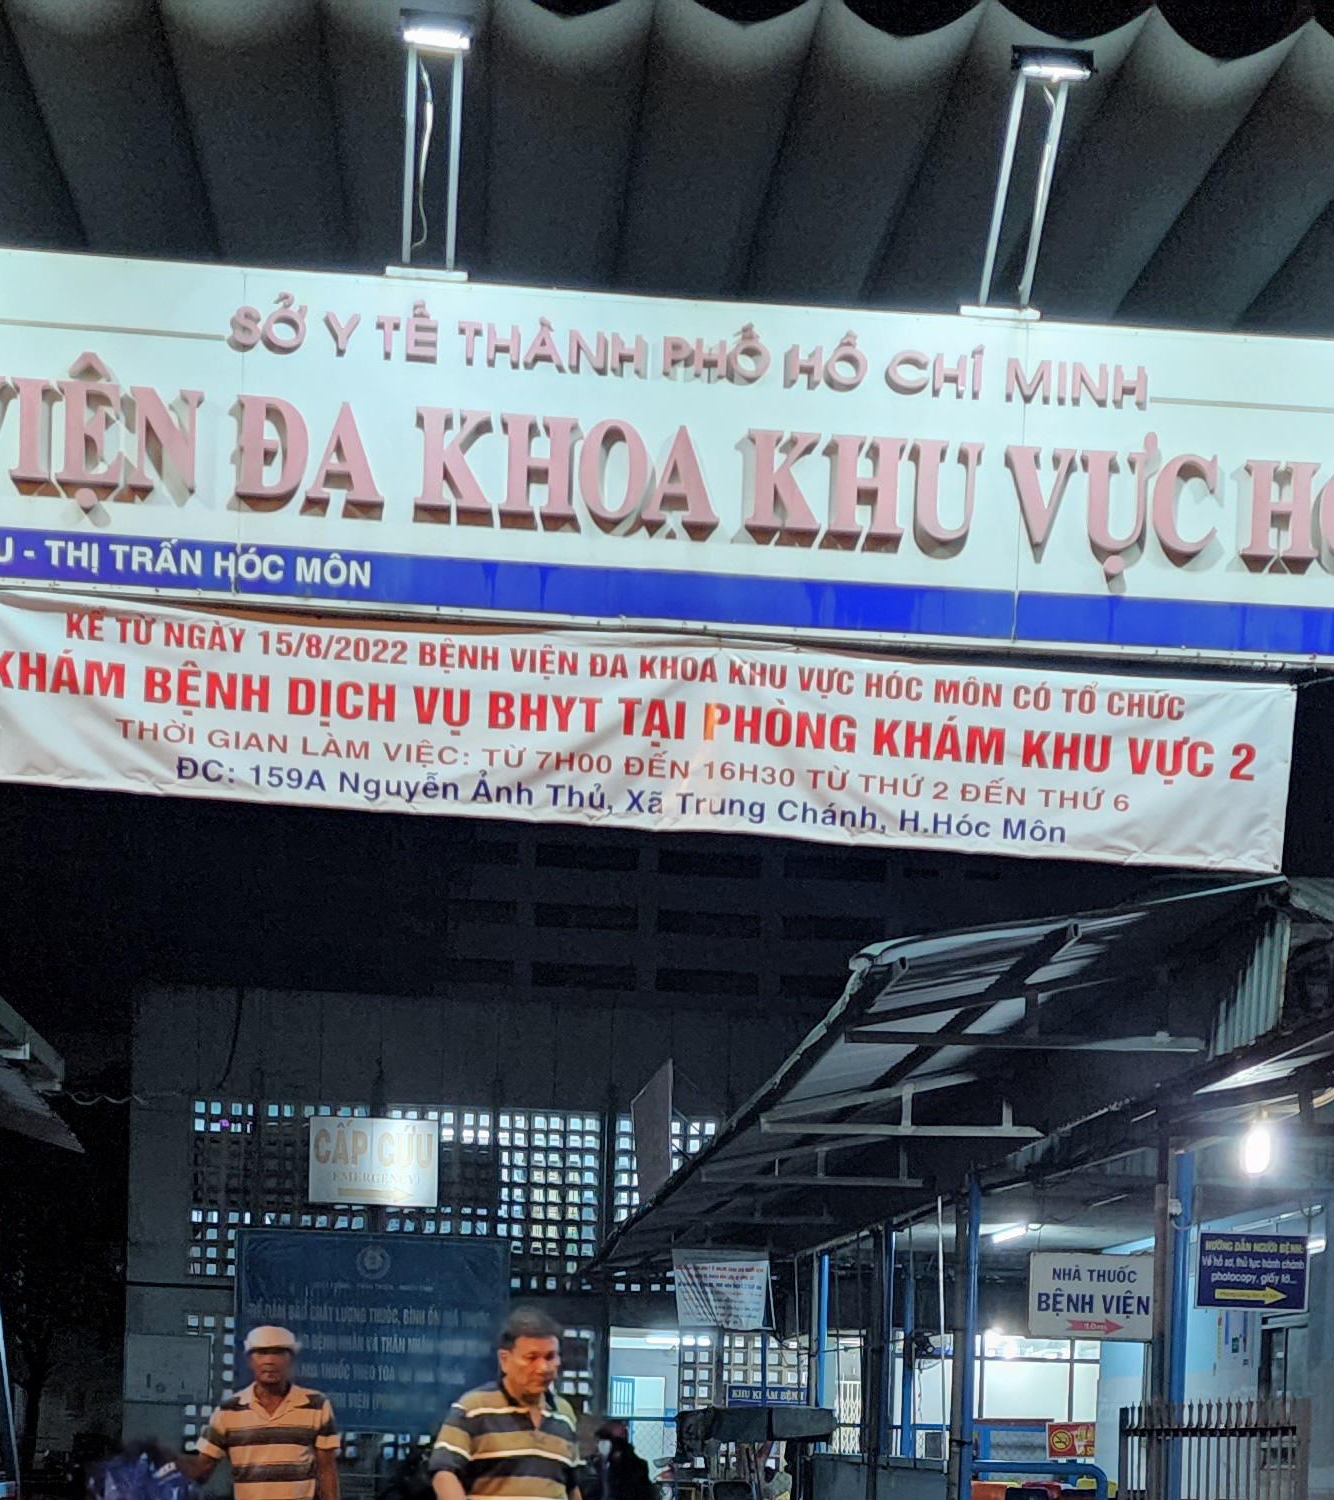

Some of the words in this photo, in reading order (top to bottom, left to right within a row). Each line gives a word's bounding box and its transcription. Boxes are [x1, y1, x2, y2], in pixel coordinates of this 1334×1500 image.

[228, 292, 308, 354] SỞ
[323, 311, 361, 357] Y
[376, 299, 438, 364] TẾ
[458, 316, 647, 379] THÀNH
[884, 344, 985, 400] CHÍ
[1005, 357, 1148, 410] MINH
[234, 393, 385, 520] ĐA
[413, 401, 720, 543] KHOA
[744, 428, 985, 560] KHU
[1004, 431, 1220, 591] VỰC
[45, 541, 100, 577] THỊ
[113, 539, 201, 578] TRẤN
[212, 545, 284, 584] HÓC
[296, 549, 372, 588] MÔN
[117, 611, 156, 646] TỪ
[164, 620, 247, 653] NGÀY
[257, 630, 408, 667] 15/8/2022
[417, 635, 499, 674] BỆNH
[510, 643, 579, 681] VIỆN
[588, 653, 628, 680] ĐA
[639, 655, 718, 683] KHOA
[728, 660, 789, 690] KHU
[797, 667, 854, 701] VỰC
[864, 667, 924, 702] HÓC
[933, 674, 1002, 708] MÔN
[1013, 681, 1051, 712] CÓ
[1061, 680, 1098, 716] TỔ
[1106, 688, 1187, 721] CHỨC
[115, 716, 196, 746] THỜI
[206, 727, 289, 753] GIAN
[301, 729, 370, 761] LÀM
[382, 737, 470, 768] VIỆC:
[481, 743, 527, 769] TỪ
[534, 748, 613, 774] 7H00
[623, 749, 690, 780] ĐẾN
[703, 760, 795, 788] 16H30
[806, 766, 851, 793] TỪ
[862, 770, 924, 798] THỨ
[932, 780, 950, 800] 2
[960, 779, 1027, 806] ĐẾN
[1037, 782, 1105, 811] THỨ
[1112, 792, 1131, 813] 6
[142, 660, 269, 716] BỆNH
[287, 677, 397, 727] DỊCH
[413, 685, 470, 737] VỤ
[487, 691, 603, 734] BHYT
[618, 696, 686, 741] TẠI
[703, 699, 857, 756] PHÒNG
[872, 713, 1006, 767] KHÁM
[1021, 730, 1111, 773] KHU
[1127, 733, 1215, 786] VỰC
[1229, 742, 1256, 782] 2
[175, 758, 236, 785] ĐC:
[249, 764, 326, 793] 159A
[338, 770, 460, 805] Nguyễn
[545, 782, 615, 815] Thủ,
[626, 789, 664, 815] Xã
[675, 791, 766, 824] Trung
[776, 796, 887, 835] Chánh,
[897, 809, 992, 841] H.Hóc
[1001, 817, 1068, 844] Môn
[314, 1120, 367, 1166] CẤP
[378, 1125, 433, 1169] CỨU
[1037, 1288, 1094, 1316] BỆNH
[1102, 1290, 1150, 1319] VIỆN
[1052, 1265, 1082, 1281] NHÀ
[1087, 1265, 1137, 1283] THUỐC
